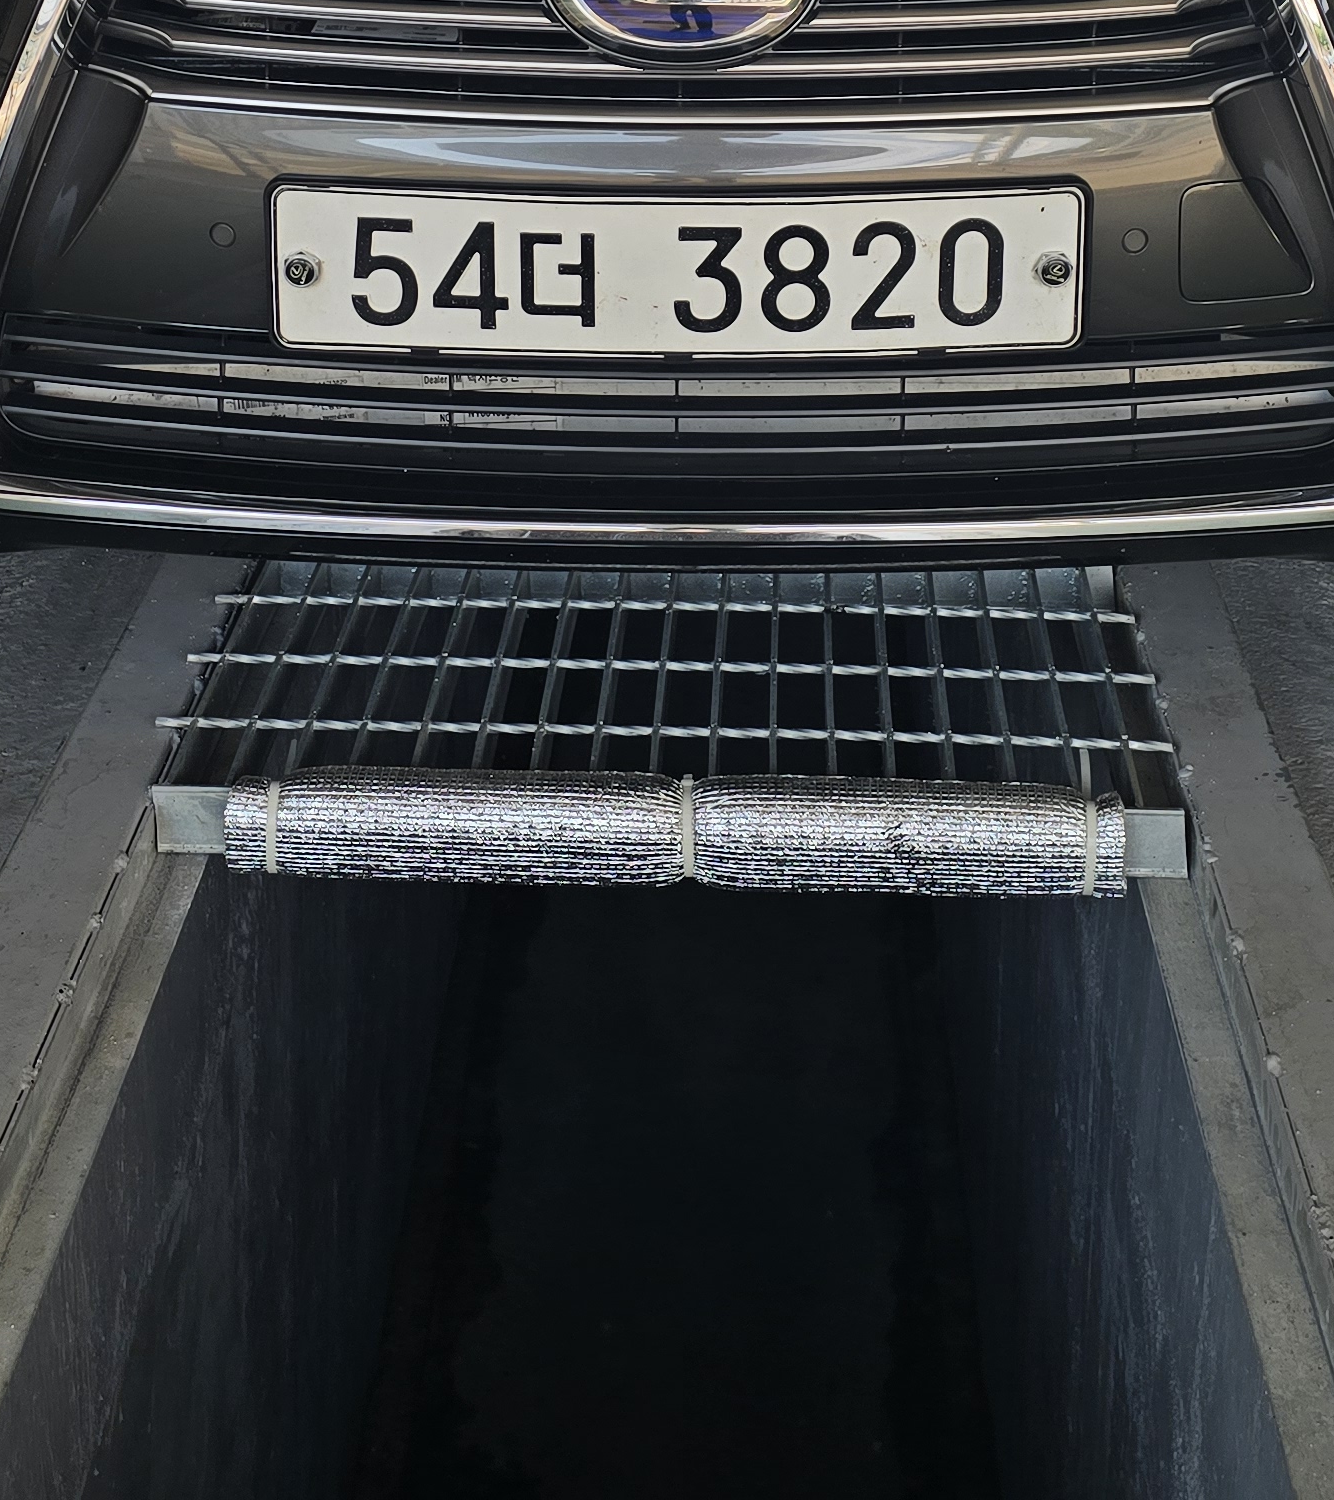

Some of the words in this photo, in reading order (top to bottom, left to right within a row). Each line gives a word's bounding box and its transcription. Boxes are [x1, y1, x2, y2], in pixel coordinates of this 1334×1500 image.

[350, 216, 598, 331] 54더
[672, 217, 1005, 333] 3820
[423, 375, 448, 385] Dealer
